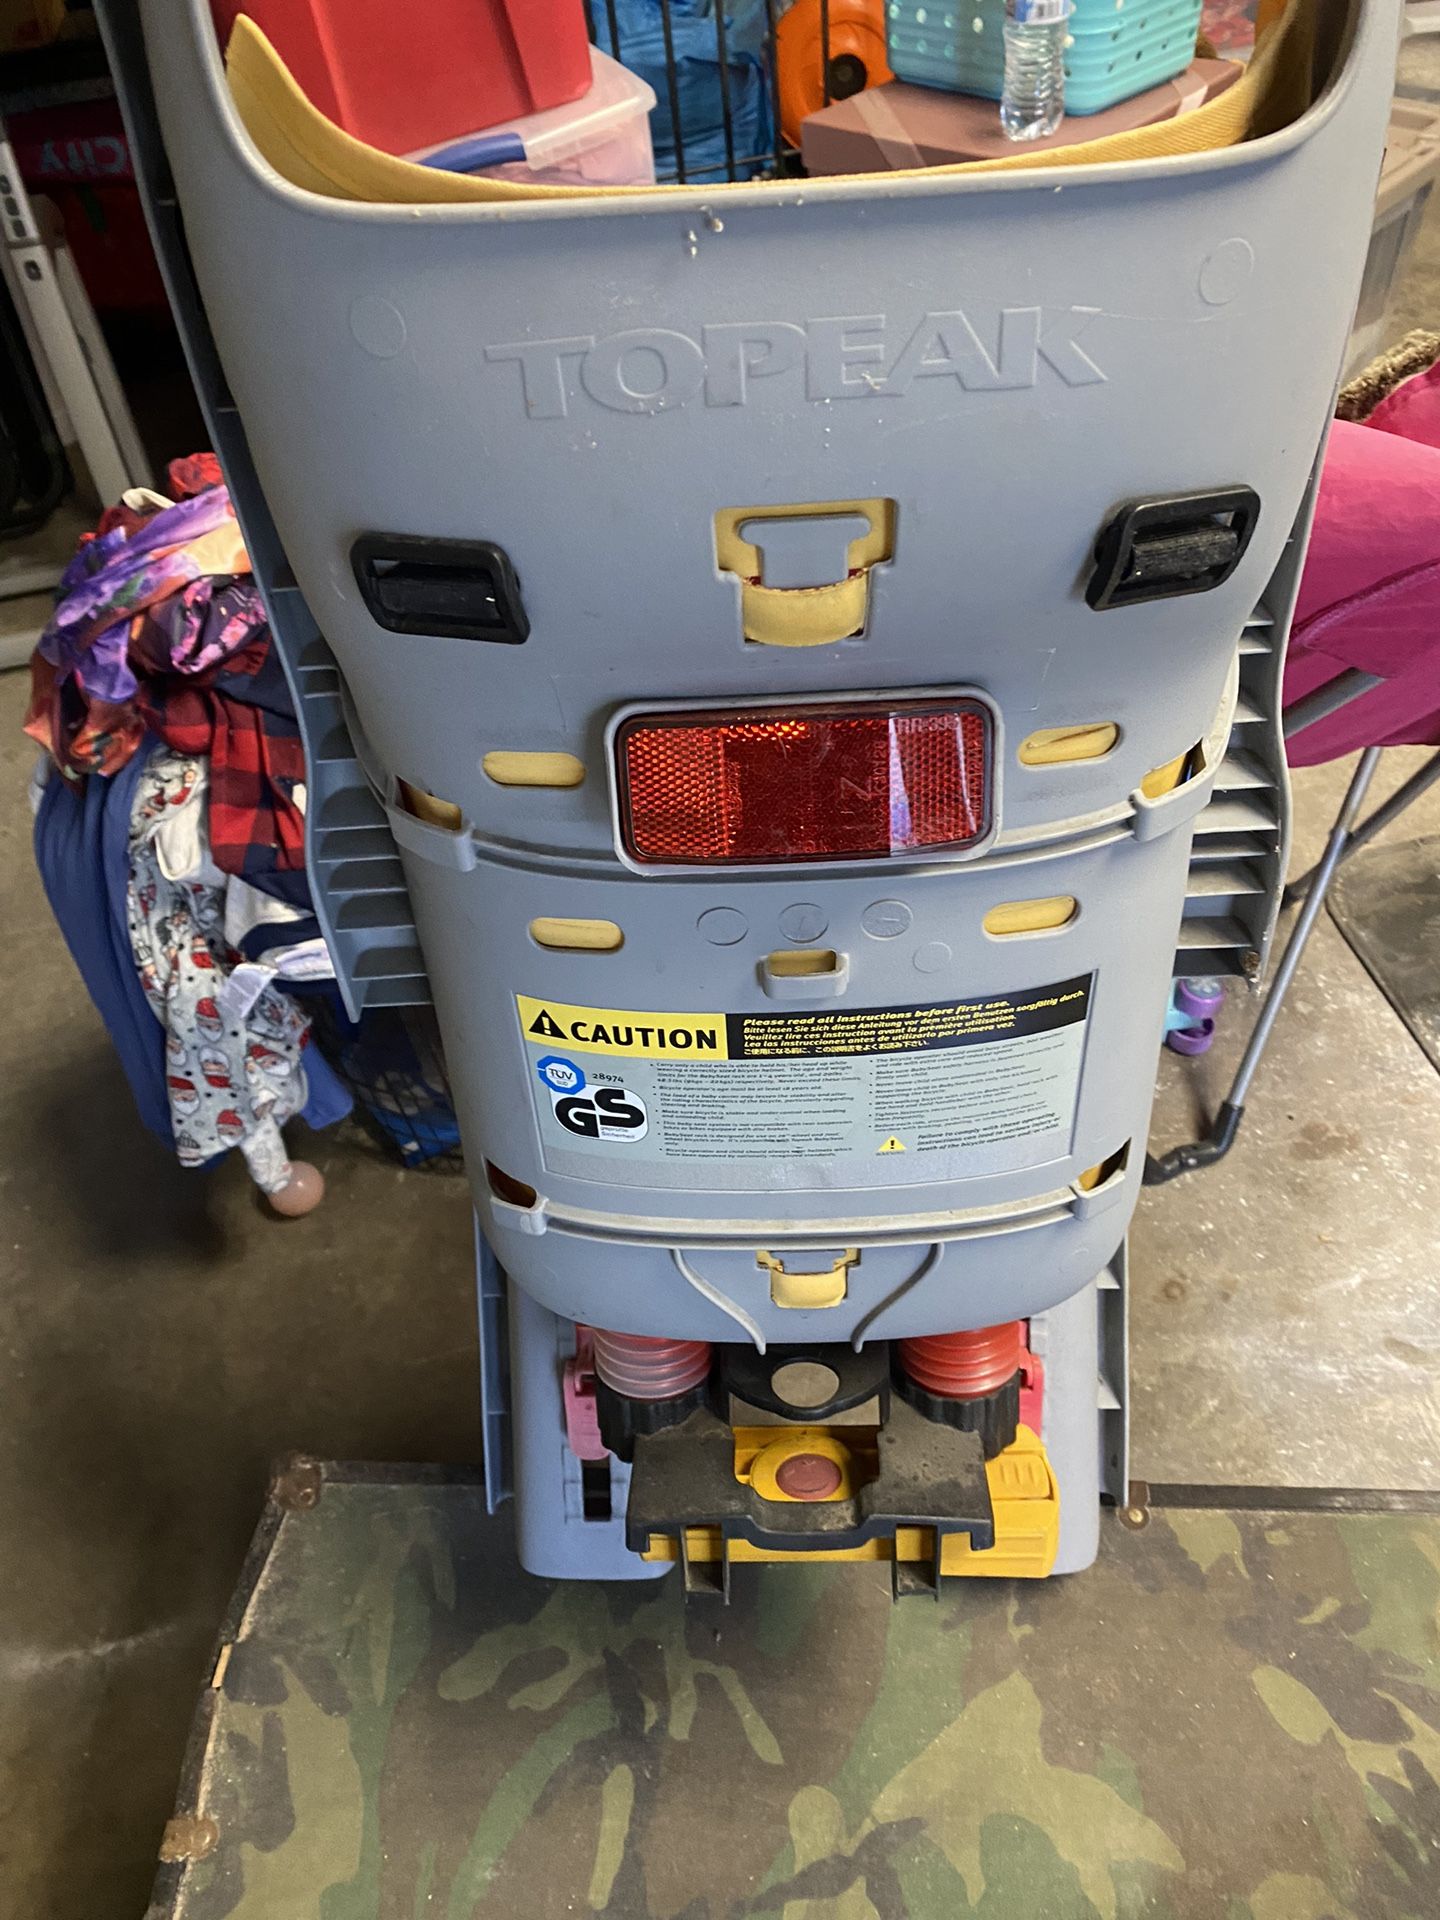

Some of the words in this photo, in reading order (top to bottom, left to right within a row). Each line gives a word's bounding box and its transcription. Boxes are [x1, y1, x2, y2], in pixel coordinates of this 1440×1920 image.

[484, 306, 1109, 420] TOPEAK
[788, 1017, 815, 1025] read
[817, 1016, 834, 1024] all
[837, 1011, 913, 1023] instructions
[914, 1008, 955, 1018] before
[956, 1004, 983, 1015] first
[985, 1001, 1010, 1009] use.
[793, 1025, 809, 1033] Sie
[810, 1024, 830, 1032] sich
[831, 1023, 856, 1031] diese
[857, 1020, 902, 1031] Anleitung
[942, 1014, 971, 1022] ersten
[972, 1007, 1015, 1018] Benutzen
[1059, 990, 1085, 1003] durch.
[570, 1021, 717, 1049] CAUTION
[744, 1033, 784, 1041] Veuillez
[822, 1029, 875, 1039] instruction
[877, 1027, 906, 1035] avant
[965, 1015, 1017, 1028] utilisation.
[781, 1037, 846, 1047] instrucciones
[847, 1036, 875, 1044] antes
[891, 1031, 937, 1041] utilizarlo
[937, 1030, 955, 1039] por
[957, 1024, 995, 1035] primera
[549, 1068, 573, 1081] TÜV
[592, 1073, 625, 1083] 28974
[555, 1088, 645, 1138] GS
